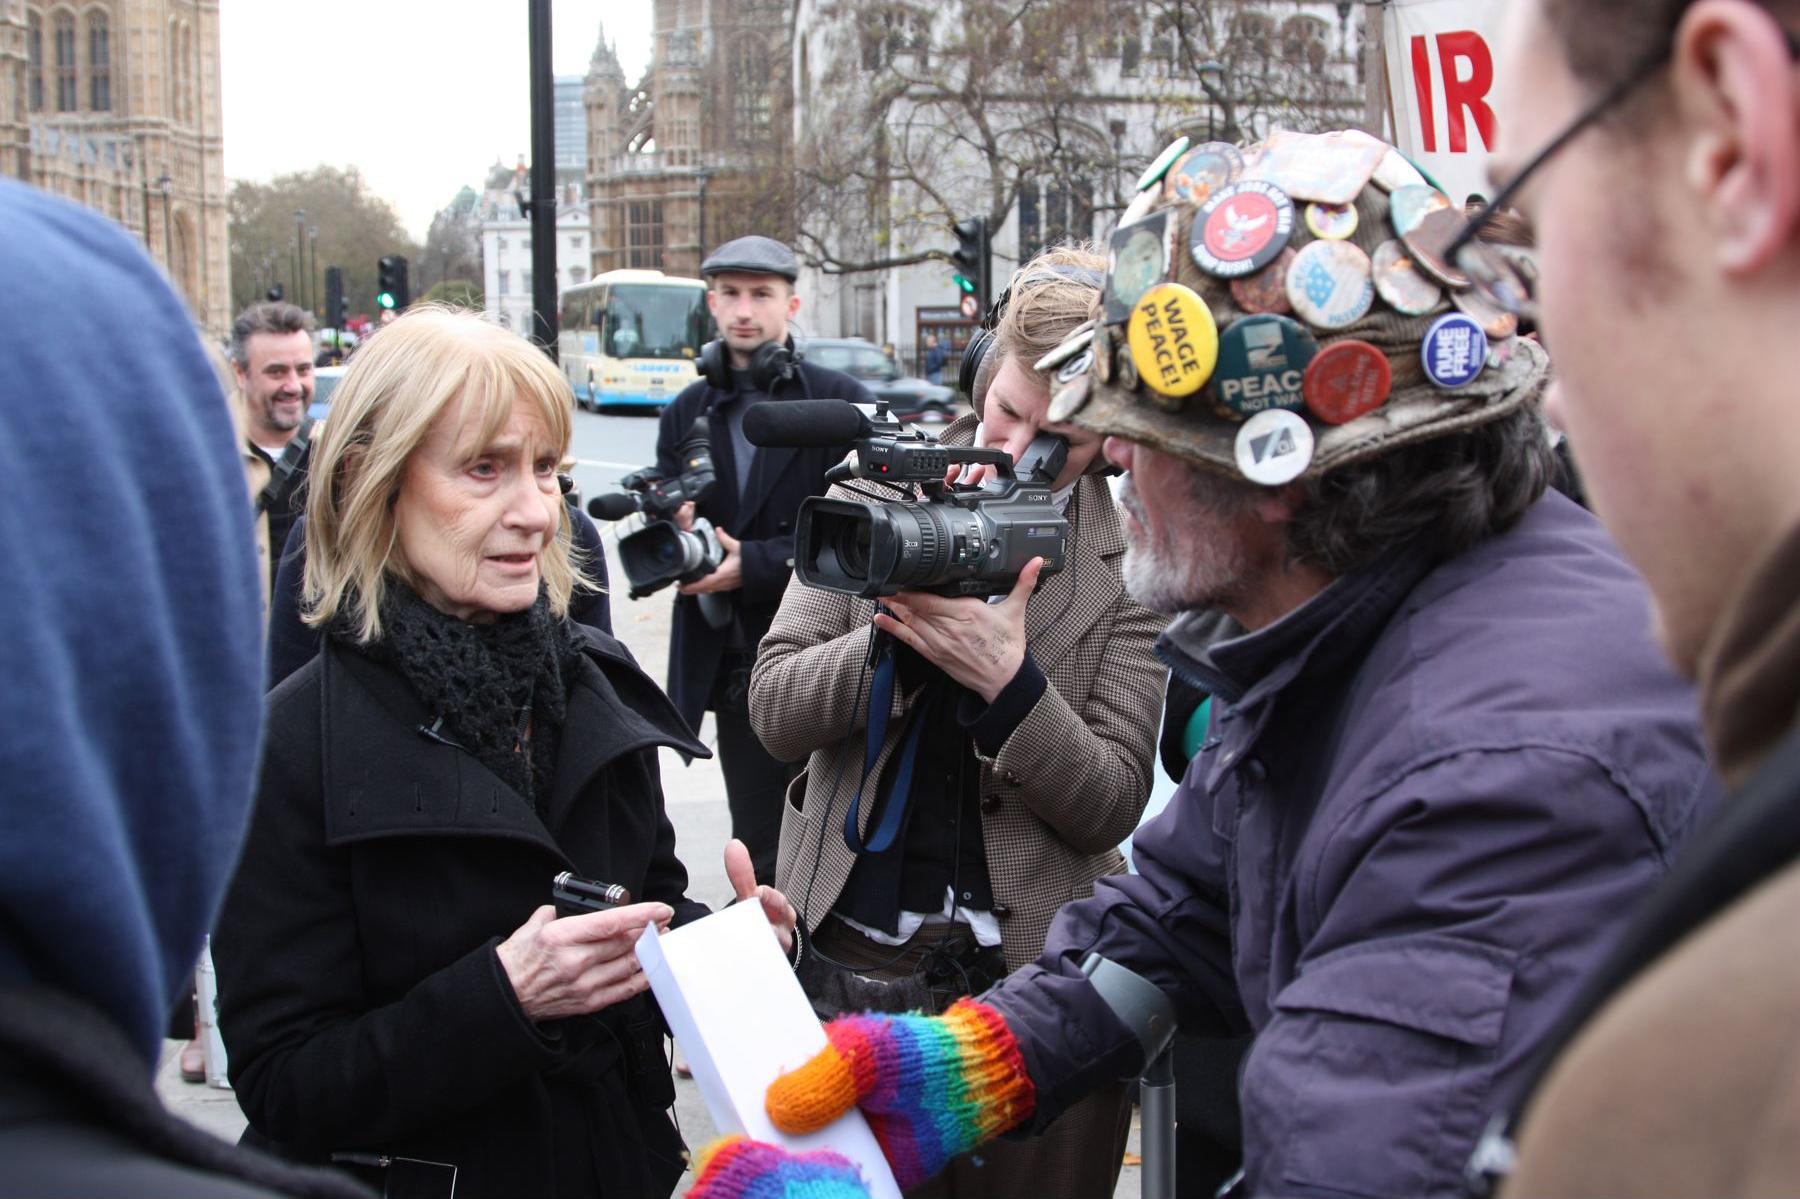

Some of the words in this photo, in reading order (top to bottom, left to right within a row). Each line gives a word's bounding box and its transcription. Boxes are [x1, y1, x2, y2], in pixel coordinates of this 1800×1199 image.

[1141, 303, 1180, 388] PEACE!
[1164, 297, 1199, 375] WAGE
[1451, 326, 1471, 377] FREE
[1221, 369, 1303, 401] PEAC
[1240, 397, 1270, 412] NOT
[871, 445, 889, 454] SONY
[1028, 494, 1048, 502] SONY
